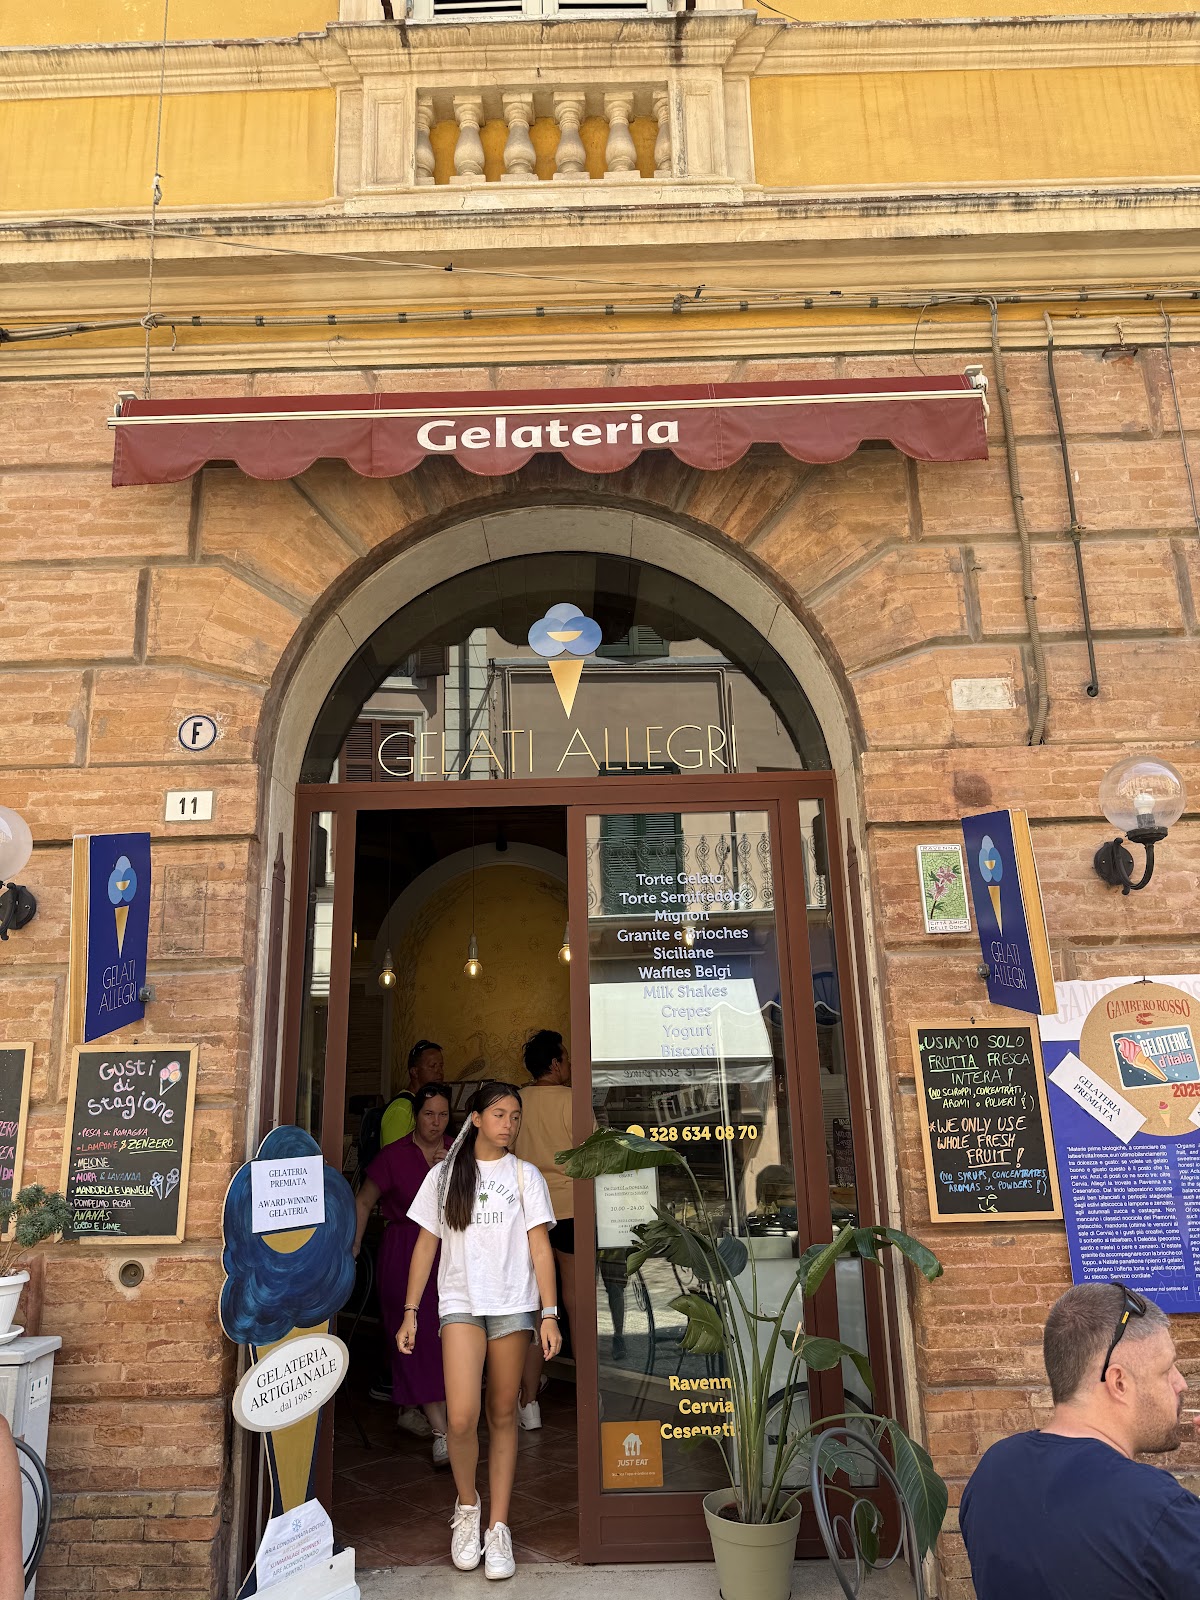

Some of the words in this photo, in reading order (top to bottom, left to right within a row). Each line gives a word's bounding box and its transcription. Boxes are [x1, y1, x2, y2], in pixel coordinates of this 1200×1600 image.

[417, 413, 680, 452] Gelateria
[192, 722, 203, 745] F
[378, 729, 533, 776] GELATI
[557, 724, 738, 772] ALLEGRI
[179, 796, 198, 815] 11
[636, 873, 673, 886] Torte
[677, 871, 724, 885] Gelato
[619, 892, 656, 905] Torte
[661, 889, 743, 904] Semifreddo
[654, 909, 710, 924] Mignon
[617, 929, 670, 942] Granite
[674, 931, 682, 941] e
[687, 927, 749, 940] Brioches
[653, 945, 714, 960] Siciliane
[990, 940, 1021, 966] GELATI
[102, 959, 136, 990] GELATI
[638, 966, 691, 980] Waffles
[695, 964, 732, 981] Belgi
[994, 964, 1028, 990] ALLEGRI
[98, 980, 137, 1016] ALLEGRI
[643, 985, 675, 999] Milk
[677, 984, 728, 998] Shakes
[661, 1004, 712, 1021] Crepes
[1106, 999, 1156, 1020] GAMBERO
[1157, 998, 1191, 1018] ROSSO
[662, 1024, 712, 1041] Yogurt
[987, 1034, 1024, 1048] SOLO
[1139, 1030, 1191, 1058] GELATERIE
[661, 1044, 716, 1058] Biscotti
[929, 1054, 977, 1069] FRUTTA
[987, 1052, 1031, 1067] FRESCA
[1158, 1052, 1193, 1069] d'Italia
[951, 1069, 1002, 1085] INTERA
[113, 1078, 136, 1093] di
[1171, 1082, 1200, 1098] 2025
[942, 1097, 970, 1109] AROMI
[984, 1096, 1016, 1108] POLVERI
[1073, 1084, 1114, 1122] PREMIATA
[1078, 1075, 1122, 1116] GELATERIA
[82, 1128, 101, 1137] PESCA
[112, 1128, 148, 1137] ROMAGNA
[649, 1127, 679, 1142] 328
[682, 1126, 712, 1141] 634
[715, 1125, 735, 1141] 08
[738, 1125, 758, 1140] 70
[937, 1117, 959, 1133] WE
[961, 1117, 991, 1136] ONLY
[997, 1116, 1027, 1132] USE
[81, 1140, 118, 1152] LAMPONE
[127, 1138, 174, 1149] ZENZERO
[937, 1134, 970, 1149] WHOLE
[977, 1133, 1016, 1148] FRESH
[77, 1157, 110, 1168] MELONE
[966, 1148, 1011, 1165] FRUIT
[76, 1173, 97, 1182] MORA
[268, 1167, 308, 1178] GELATERIA
[76, 1186, 113, 1195] MANDORLA
[270, 1178, 306, 1188] PREMIATA
[949, 1182, 980, 1193] AROMAS
[997, 1180, 1033, 1190] POWDERS
[479, 1180, 517, 1205] ARDIN
[74, 1200, 109, 1209] POMPELMO
[257, 1195, 318, 1209] AWARD-WINNING
[73, 1210, 112, 1221] ANANAS
[268, 1207, 309, 1219] GELATERIA
[470, 1211, 504, 1225] LEURI
[102, 1222, 121, 1231] LIME
[256, 1345, 328, 1389] GELATERIA
[249, 1358, 338, 1413] ARTIGIANALE
[668, 1375, 733, 1392] Ravenn
[279, 1399, 293, 1415] dal
[294, 1389, 313, 1409] 1985
[678, 1397, 735, 1415] Cervia
[660, 1421, 736, 1441] Cesenati
[617, 1459, 635, 1468] JUST
[635, 1458, 649, 1467] EAT
